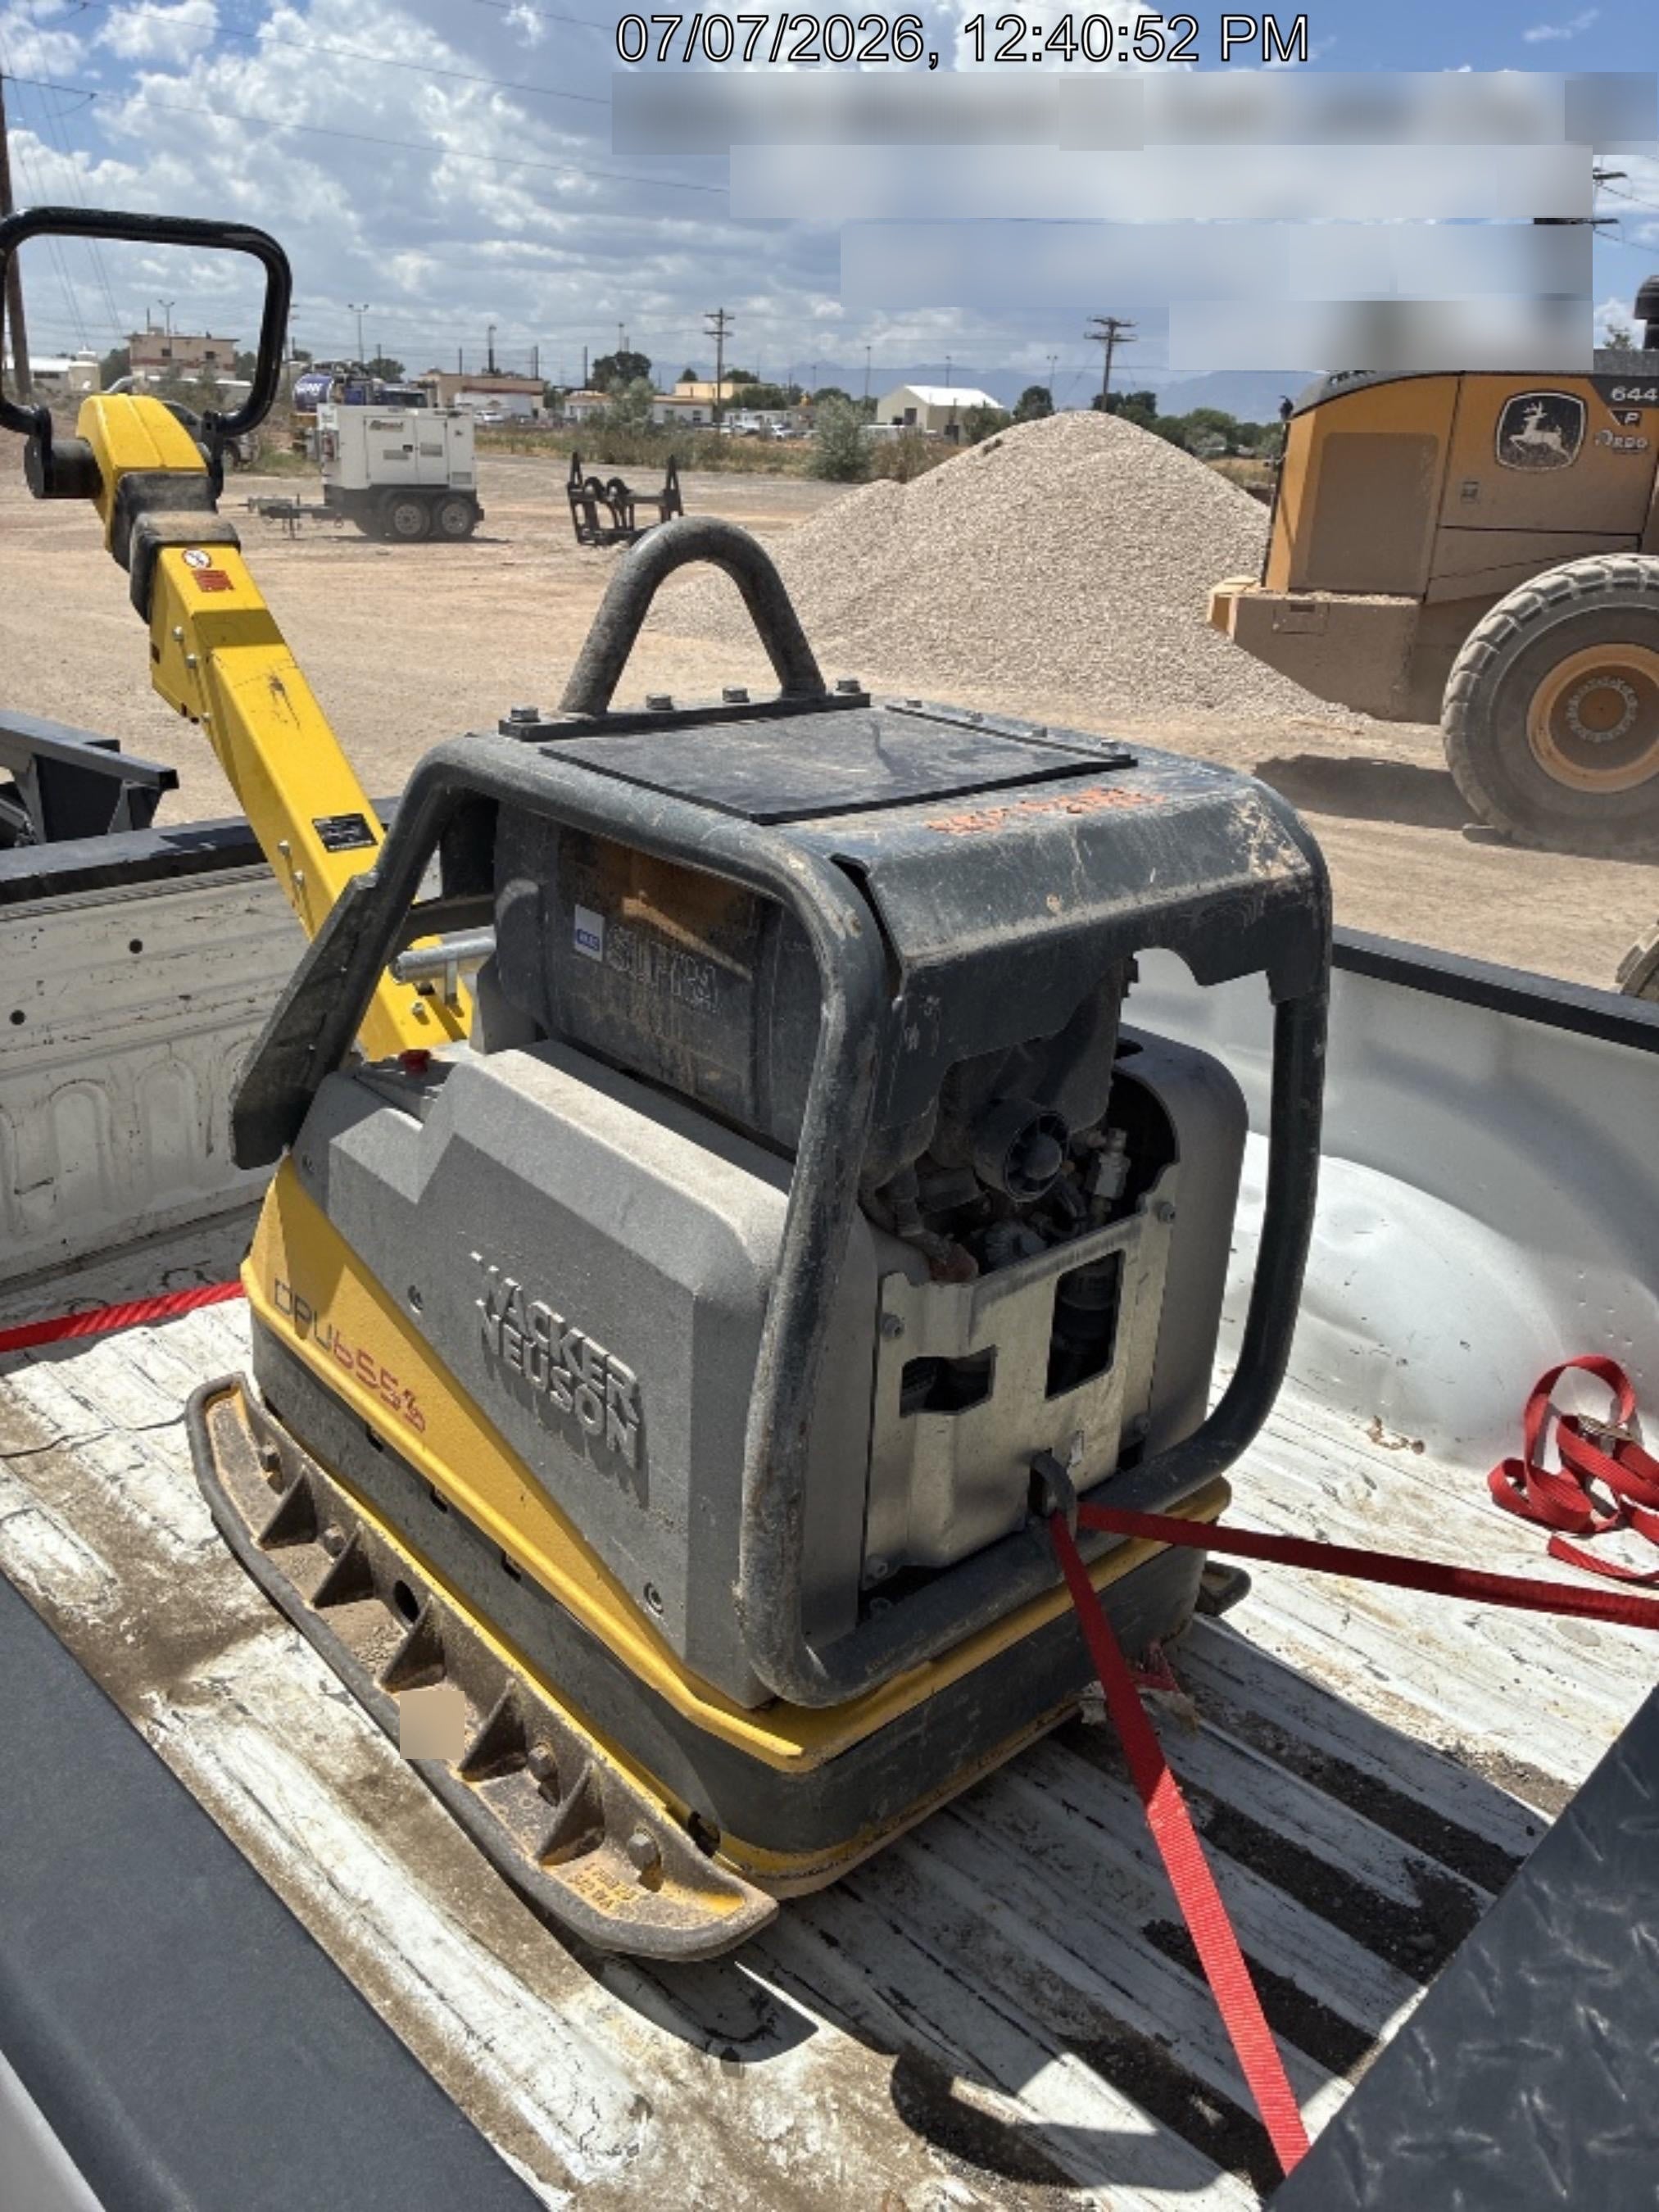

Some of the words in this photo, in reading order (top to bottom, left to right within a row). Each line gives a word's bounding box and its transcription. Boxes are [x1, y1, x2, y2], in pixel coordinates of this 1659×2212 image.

[1611, 386, 1657, 401] 644
[1625, 412, 1639, 424] P
[469, 1251, 644, 1425] WACKER
[475, 1299, 640, 1472] NEUSON
